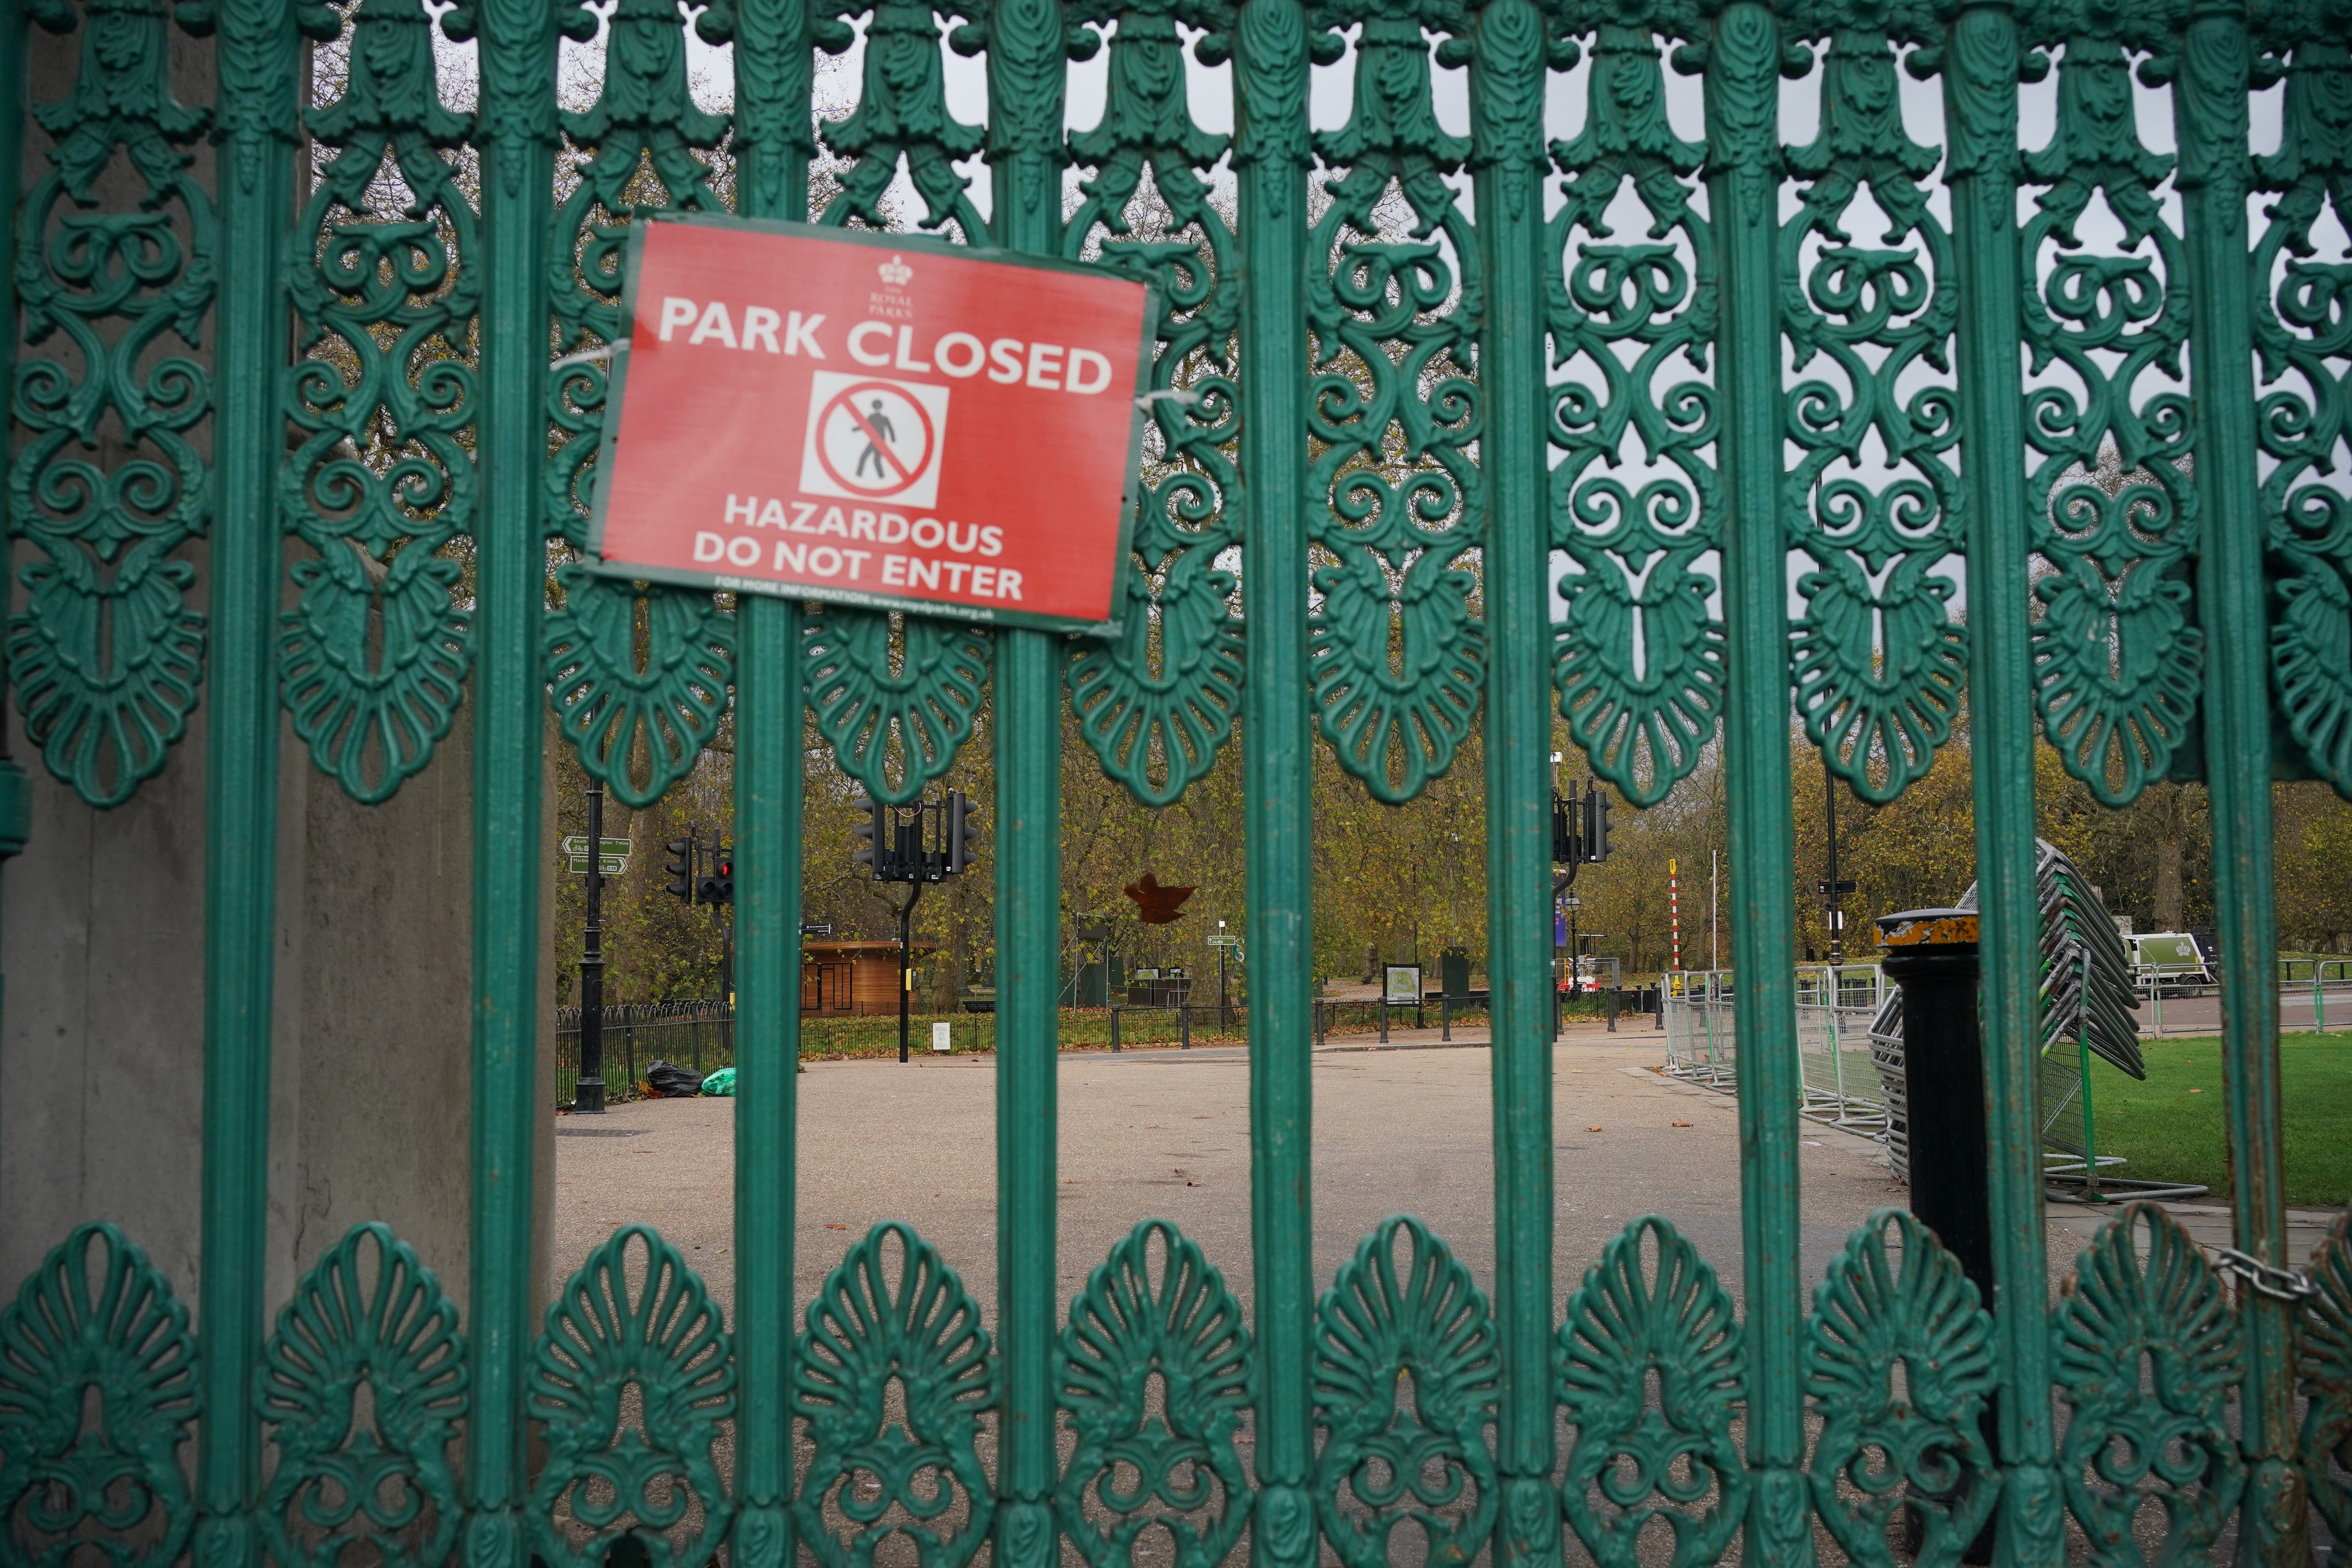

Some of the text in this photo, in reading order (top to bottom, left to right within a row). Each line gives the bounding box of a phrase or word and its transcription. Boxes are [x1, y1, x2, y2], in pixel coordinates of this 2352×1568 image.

[869, 304, 913, 319] PARKS
[870, 292, 913, 307] ROYAL
[659, 297, 1112, 394] PARK CLOSED
[724, 494, 1002, 556] HAZARDOUS
[694, 532, 1022, 600] DO NOT ENTER
[715, 575, 740, 588] FOR
[742, 579, 779, 593] MORE
